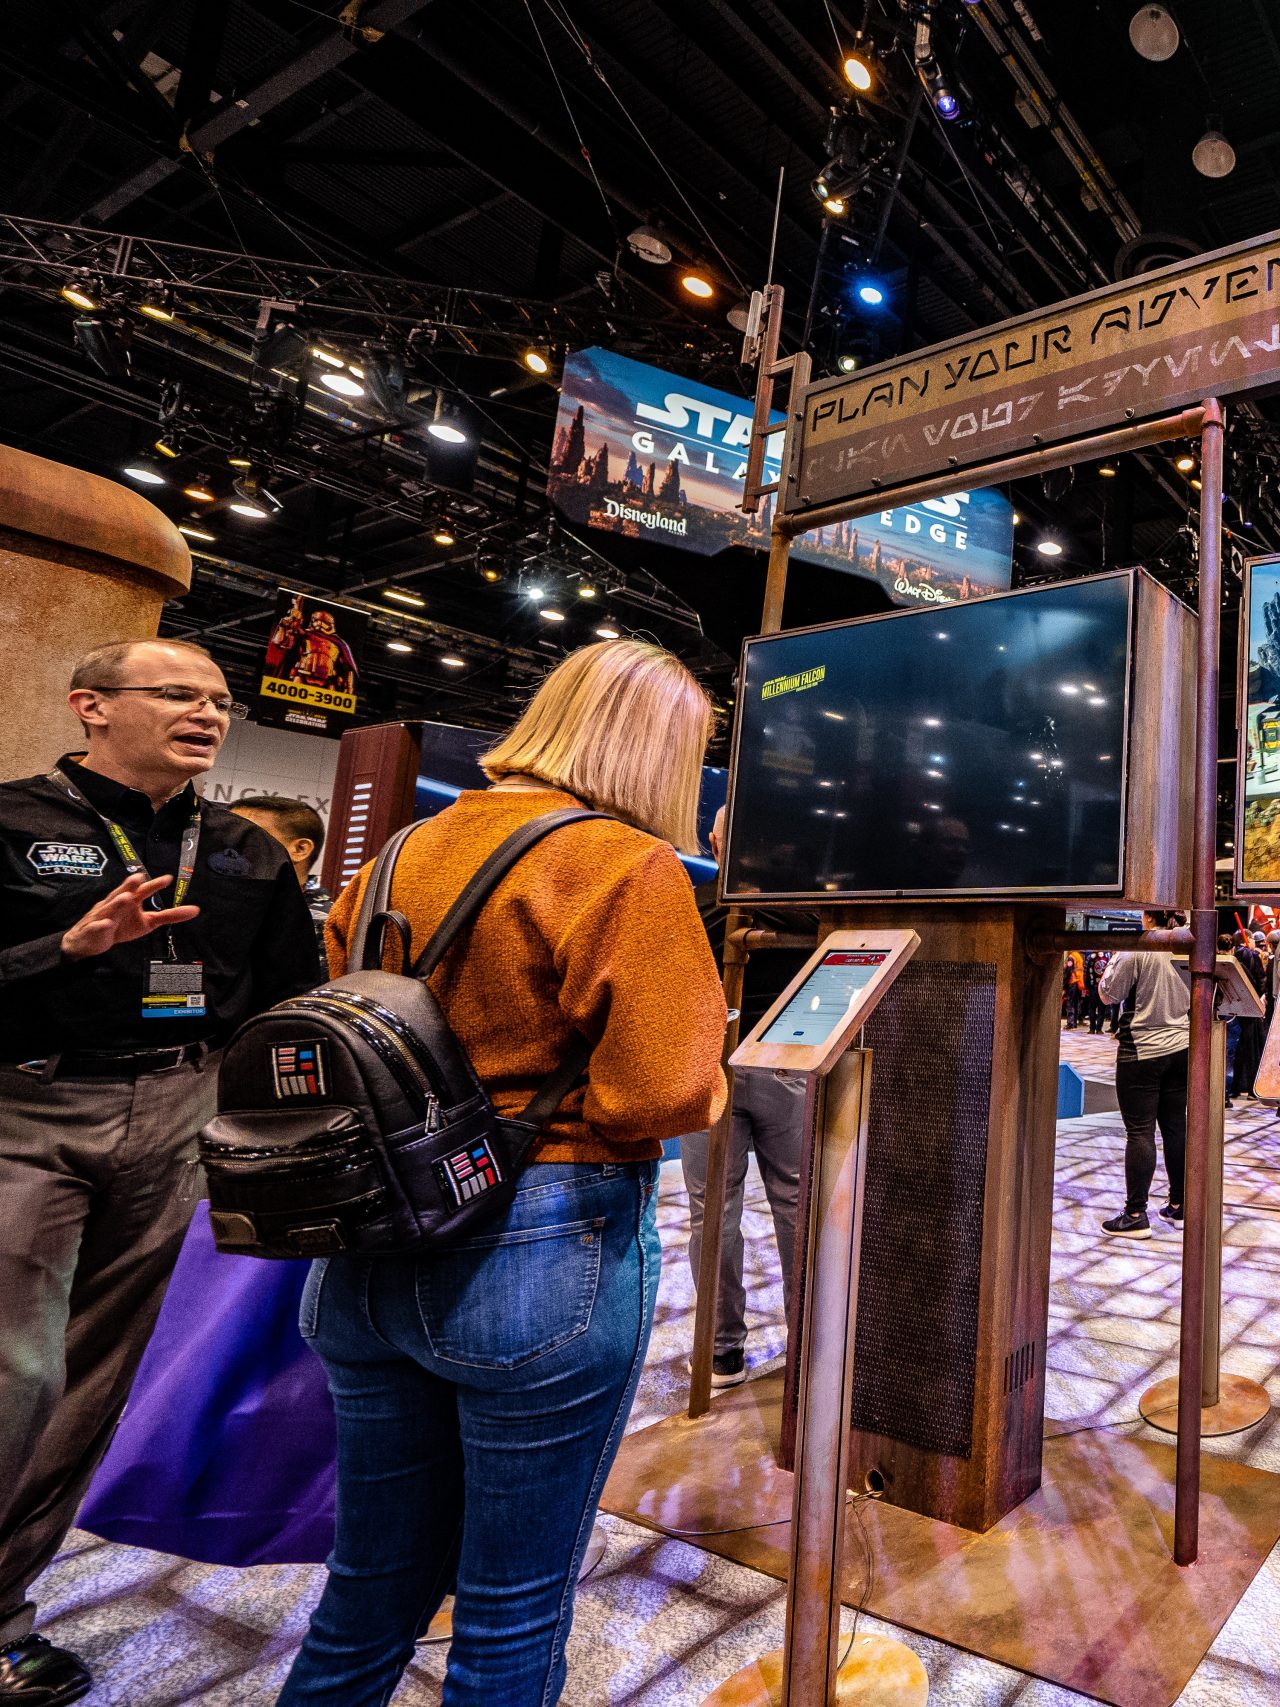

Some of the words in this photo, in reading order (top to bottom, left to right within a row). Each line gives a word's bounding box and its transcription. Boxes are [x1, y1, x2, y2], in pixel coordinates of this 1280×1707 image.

[812, 370, 930, 432] PLAN
[945, 324, 1072, 390] YOUR
[603, 497, 687, 534] Disneyland
[880, 509, 968, 551] EDGE
[266, 682, 353, 709] 4000-3900
[762, 675, 800, 699] MILLENNIUM
[801, 667, 825, 686] FALCON
[38, 845, 98, 857] STAR
[40, 853, 99, 865] WARS
